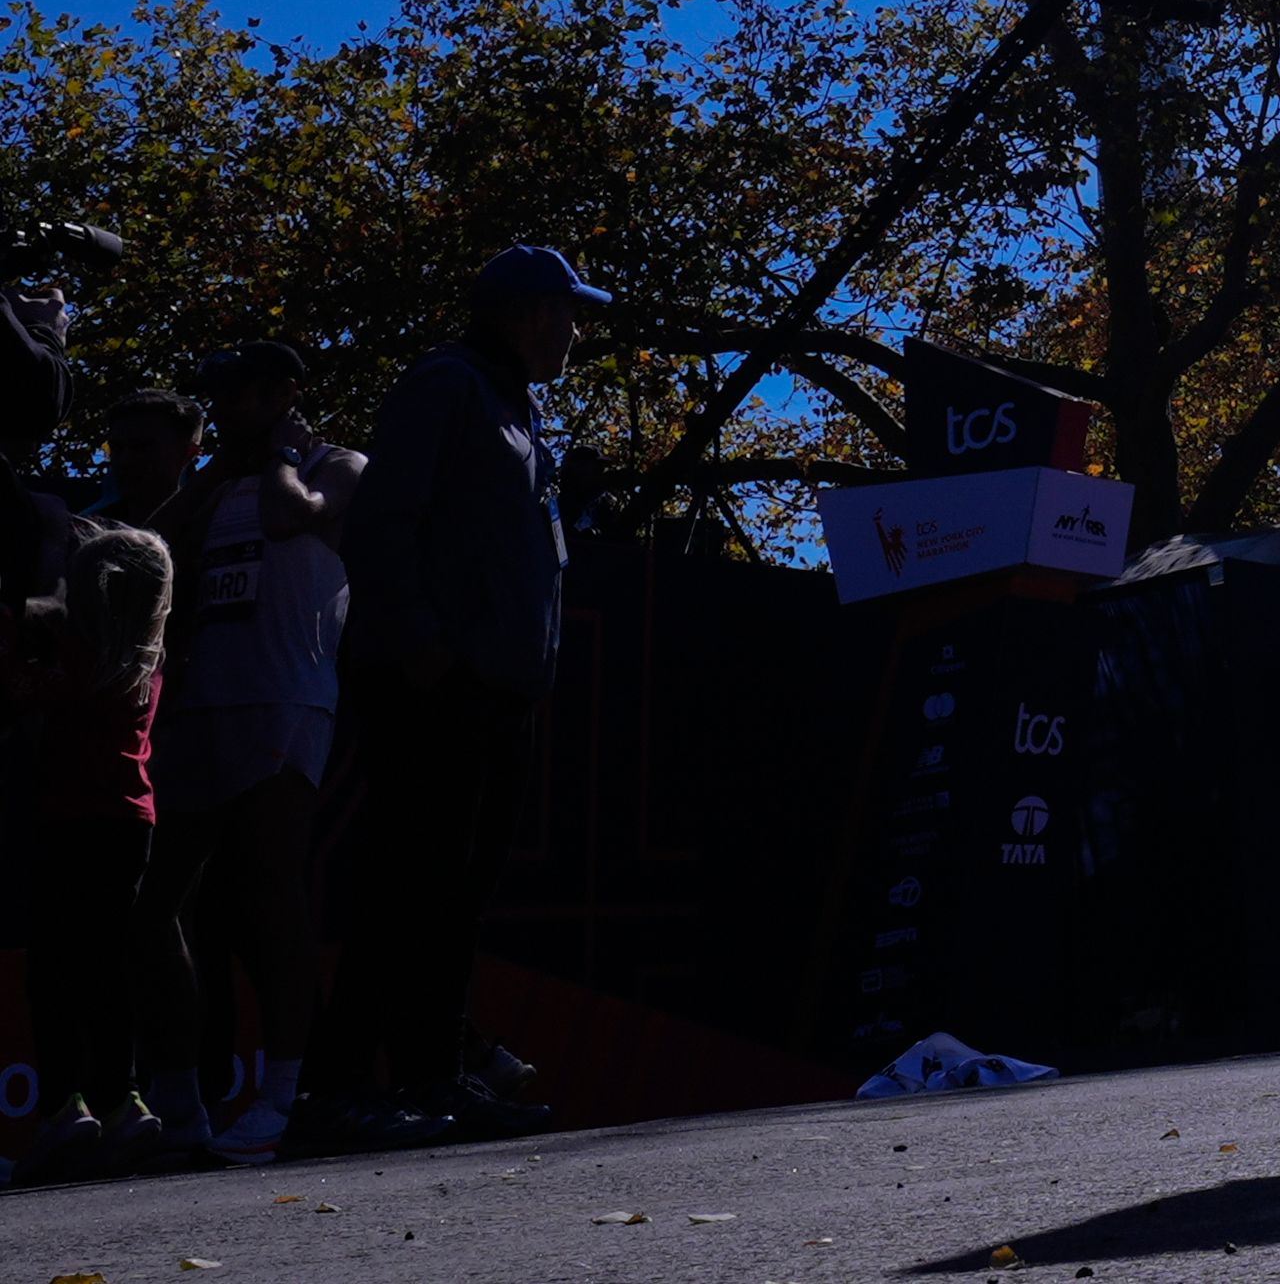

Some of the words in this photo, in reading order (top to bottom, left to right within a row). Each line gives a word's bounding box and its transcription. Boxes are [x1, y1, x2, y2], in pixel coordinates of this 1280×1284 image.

[947, 401, 1017, 455] tcs
[1014, 700, 1067, 757] tcs
[1000, 843, 1048, 867] TATA
